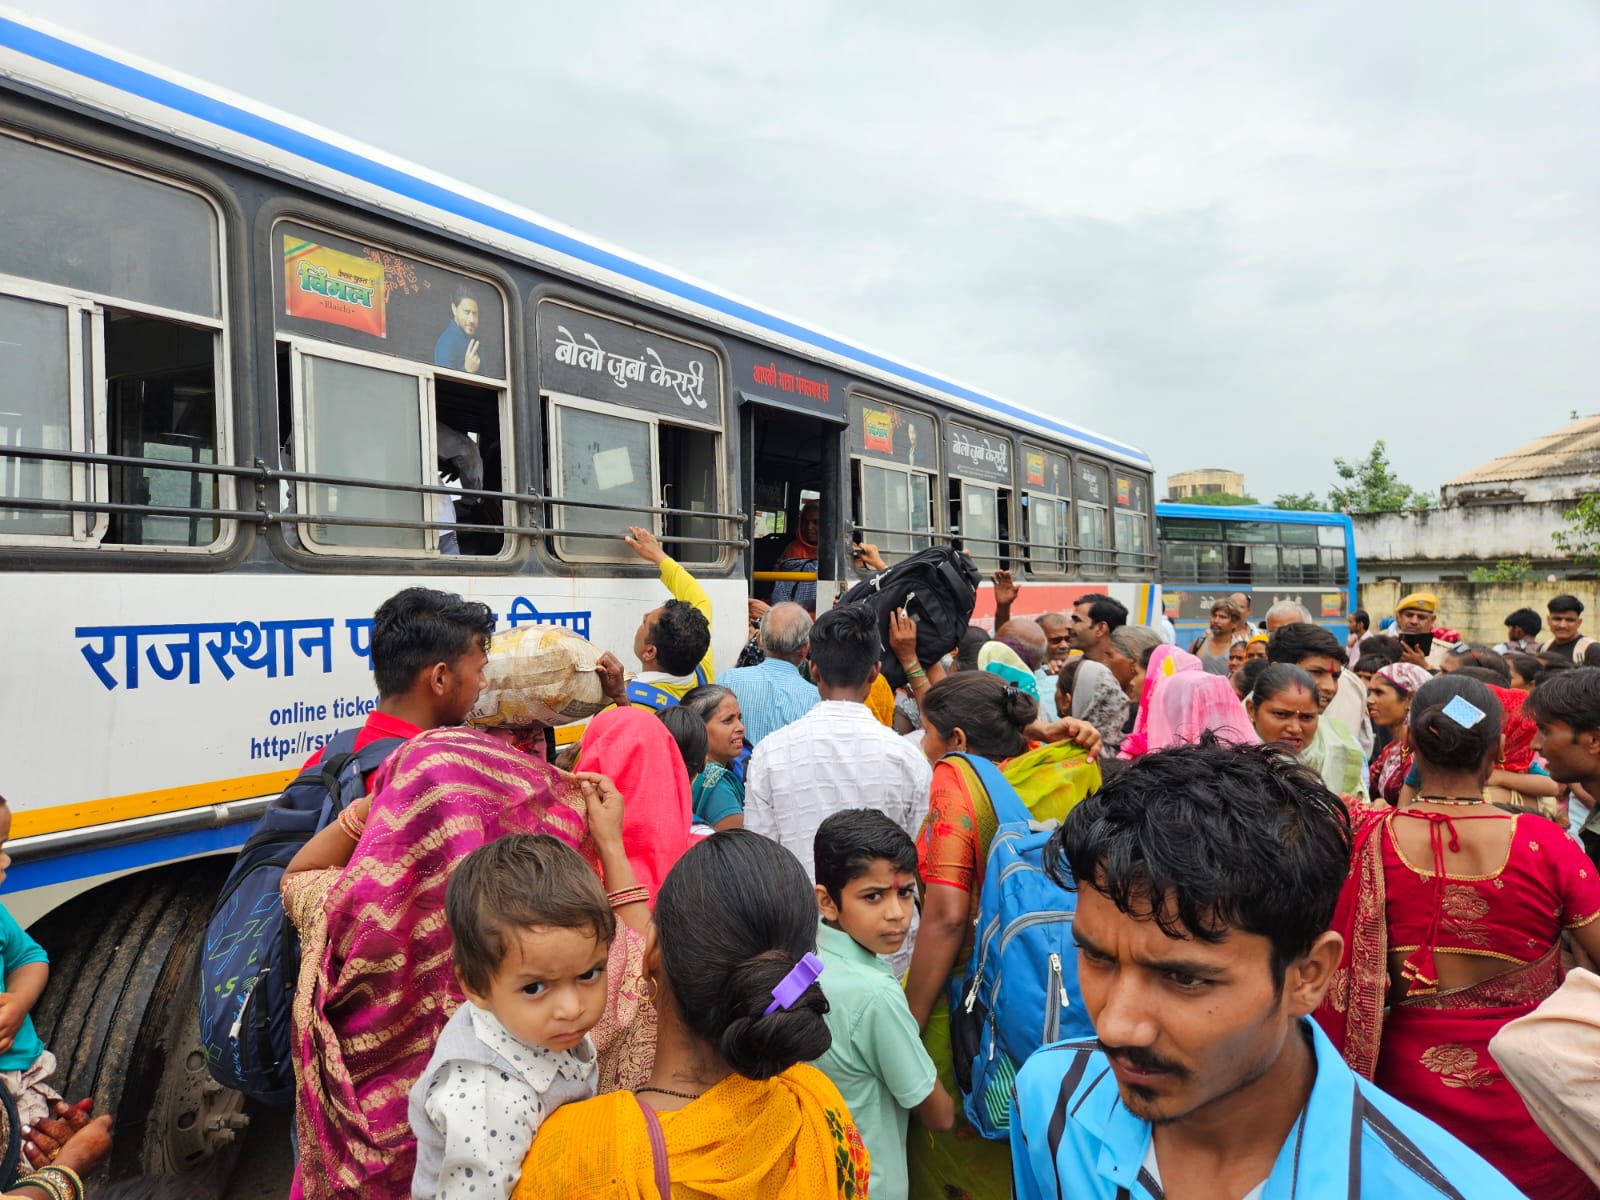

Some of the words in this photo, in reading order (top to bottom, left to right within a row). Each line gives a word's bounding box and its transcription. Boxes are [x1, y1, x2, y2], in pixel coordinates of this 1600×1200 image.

[555, 325, 606, 371] बोलो
[646, 347, 708, 409] केसरी
[75, 618, 334, 690] राजस्थान
[270, 701, 326, 726] online
